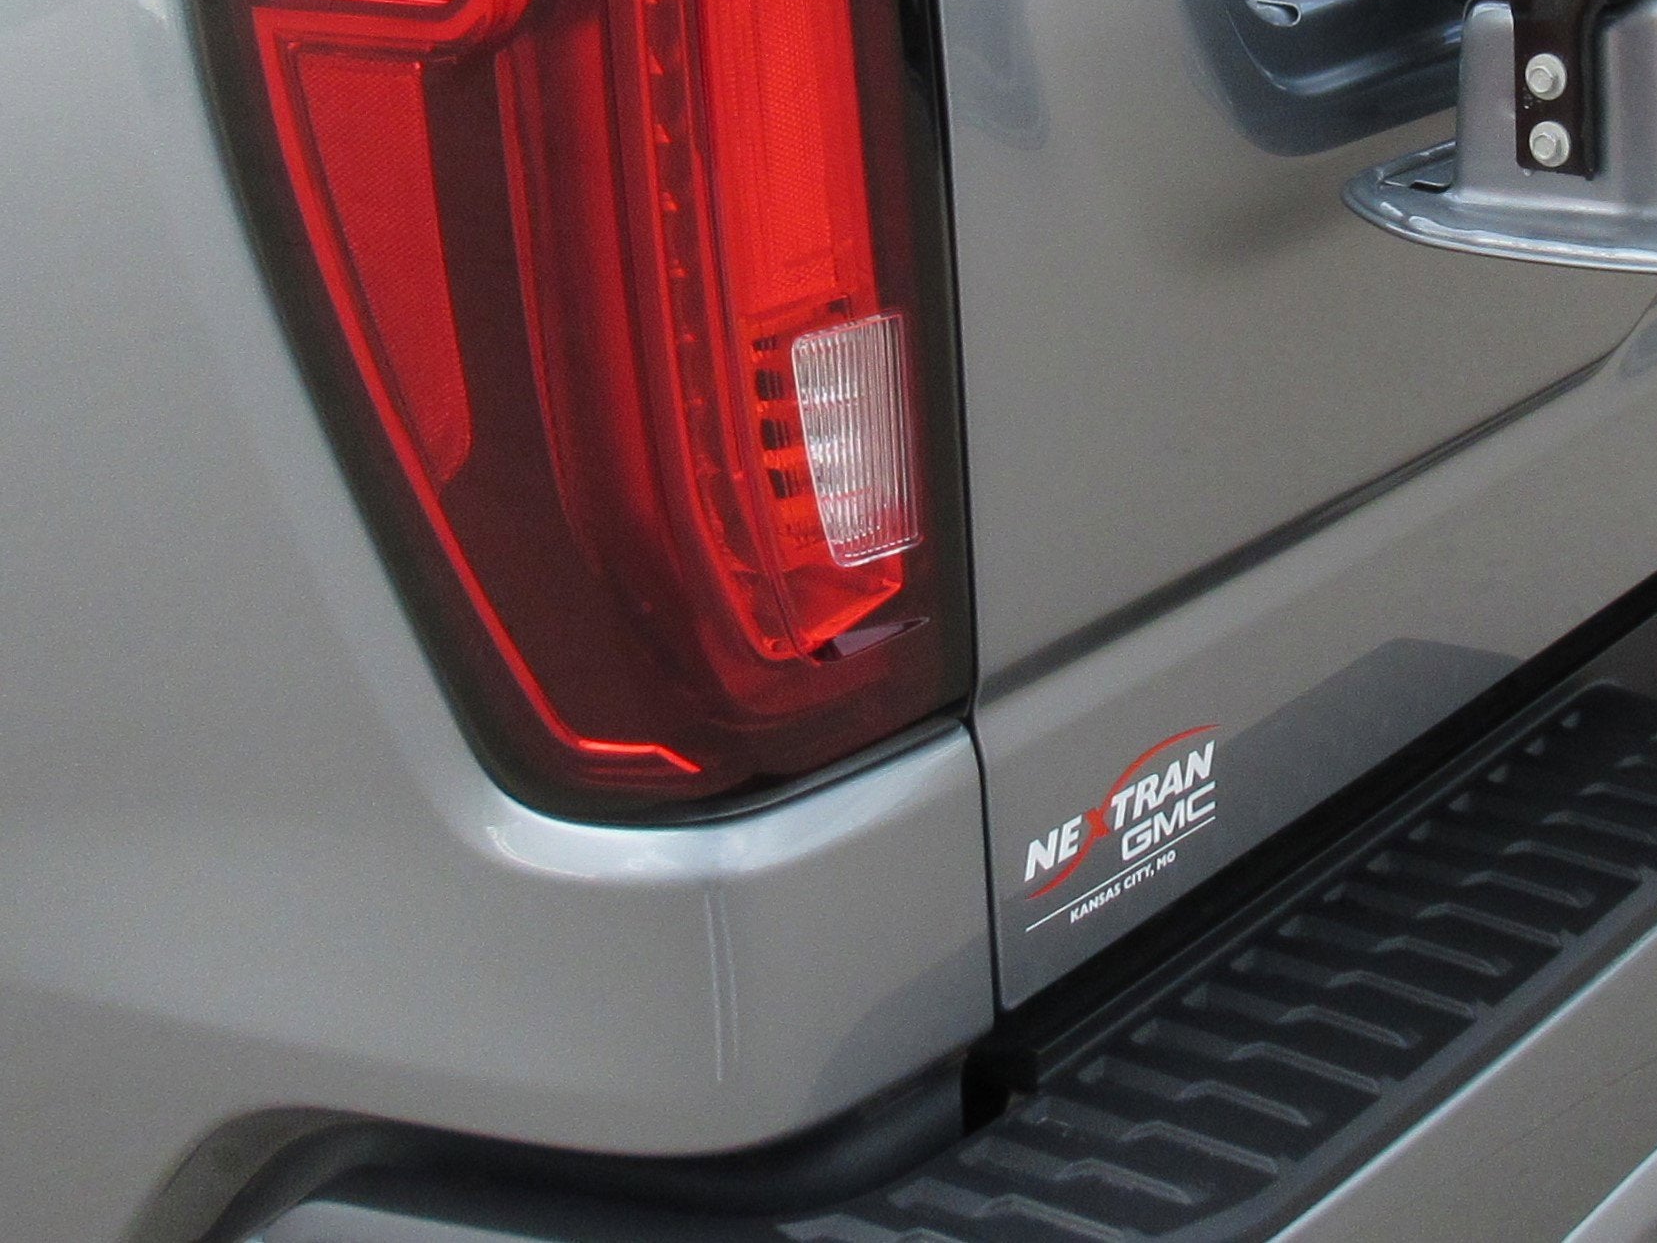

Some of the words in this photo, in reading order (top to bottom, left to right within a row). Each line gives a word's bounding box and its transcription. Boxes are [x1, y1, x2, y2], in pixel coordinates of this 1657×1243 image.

[1024, 739, 1216, 883] NEXTRAN
[1121, 780, 1216, 862] GMC
[1069, 883, 1122, 924] KANSAS
[1123, 861, 1156, 891] CITY,
[1156, 849, 1177, 872] MO
